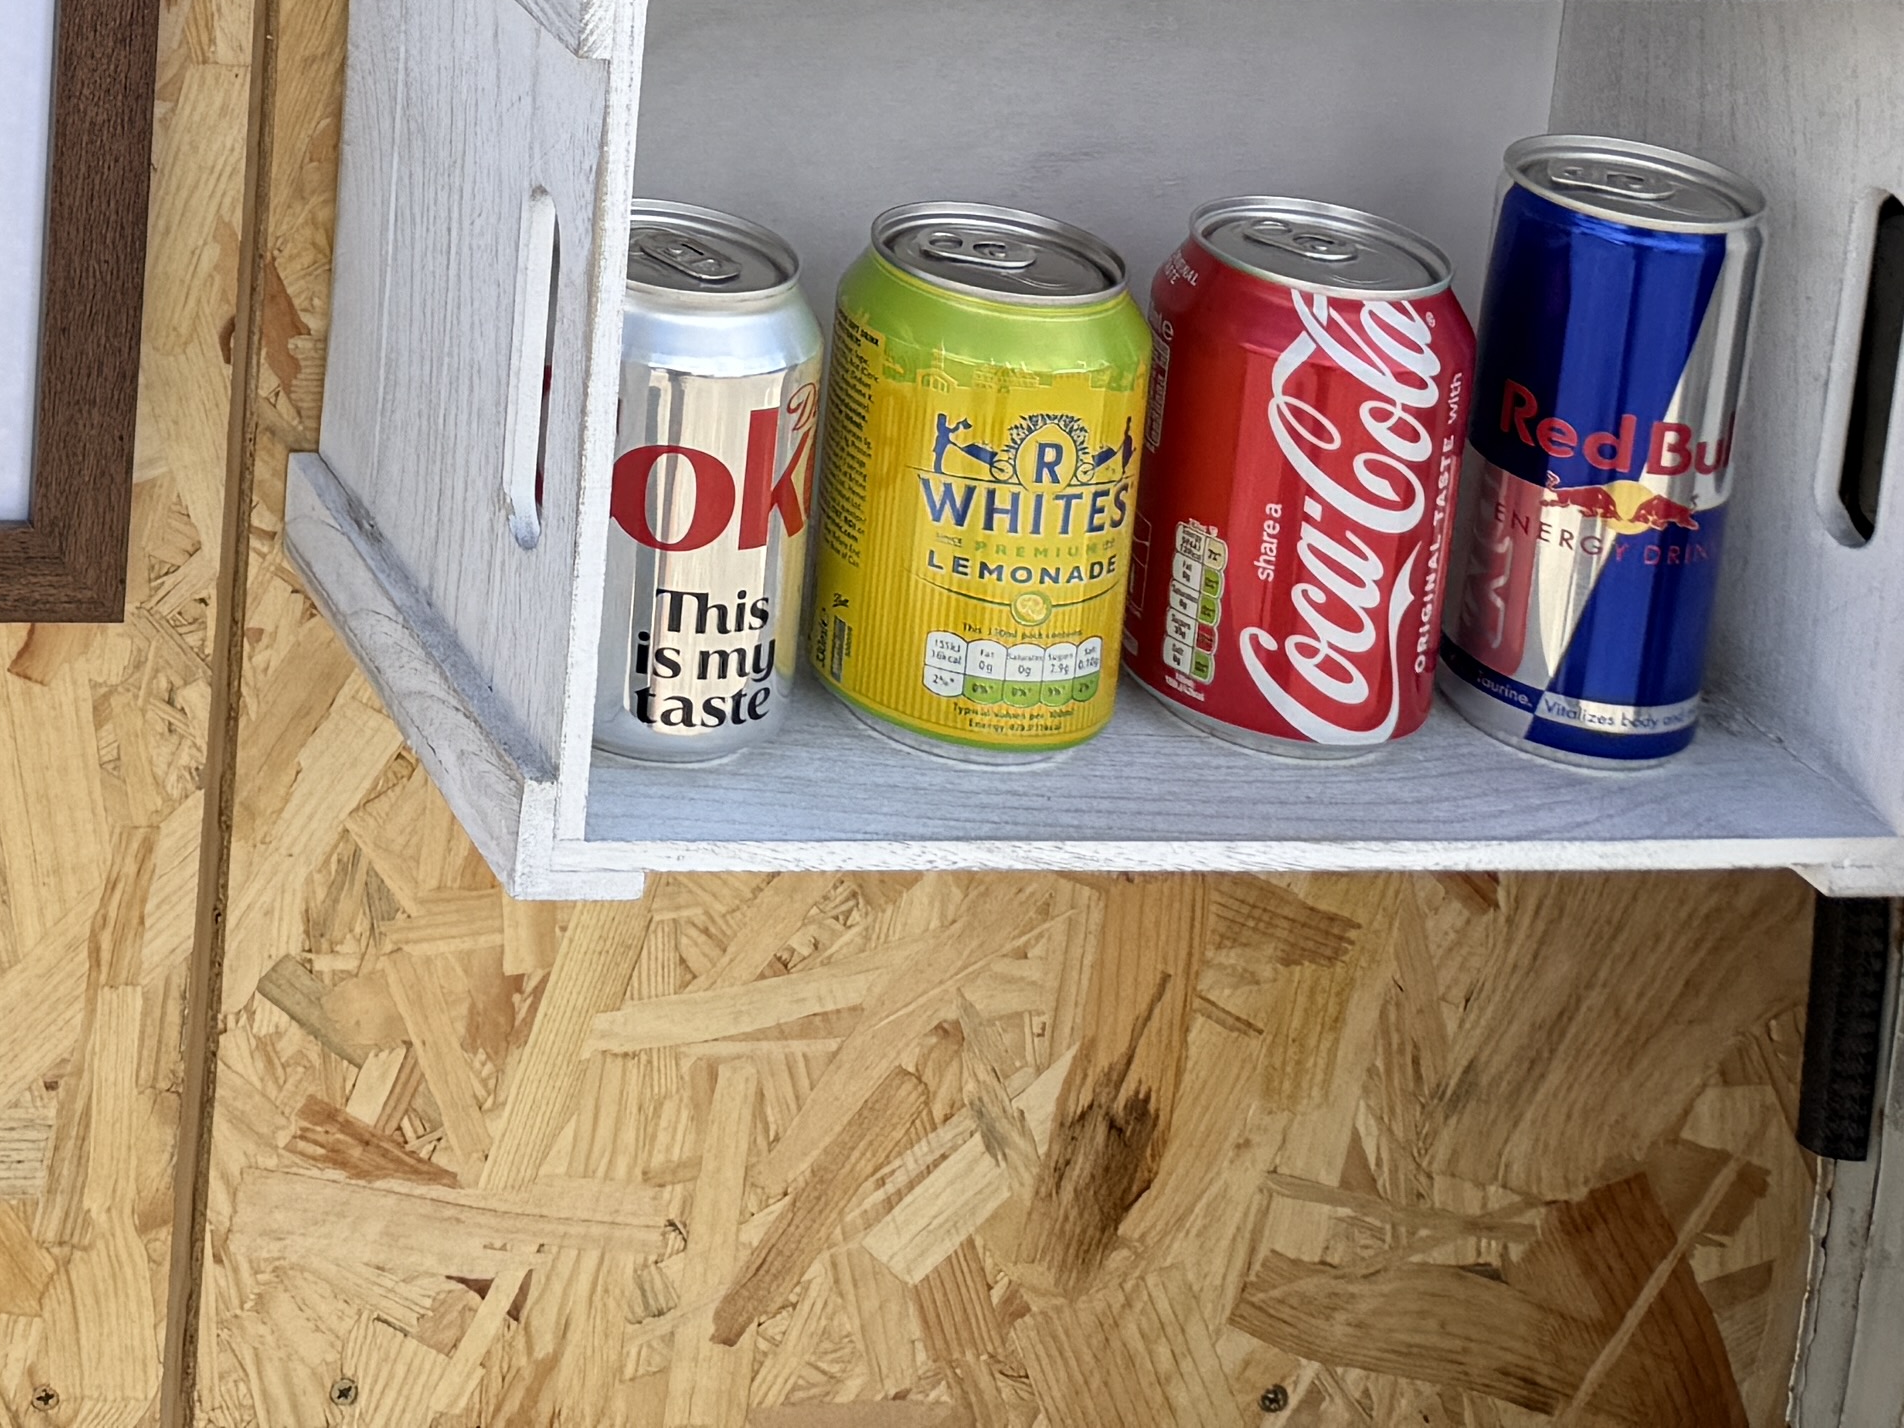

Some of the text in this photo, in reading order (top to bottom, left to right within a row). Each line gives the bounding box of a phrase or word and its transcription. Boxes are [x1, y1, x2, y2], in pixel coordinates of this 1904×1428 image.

[1499, 378, 1736, 476] Red Bul
[610, 406, 814, 553] ok
[1034, 441, 1064, 485] R
[918, 476, 1128, 536] WHITES
[1240, 287, 1446, 745] Coca-Cola
[1414, 371, 1464, 675] ORIGINAL TASTE with
[1494, 501, 1711, 566] ENERGY DRIN
[927, 549, 1117, 585] LEMONADE
[974, 539, 1098, 559] PREMIUM
[1257, 502, 1284, 582] share a
[658, 587, 770, 634] This
[634, 631, 686, 680] is
[695, 636, 775, 684] my
[634, 683, 771, 730] taste
[1544, 697, 1616, 727] Vitalizes
